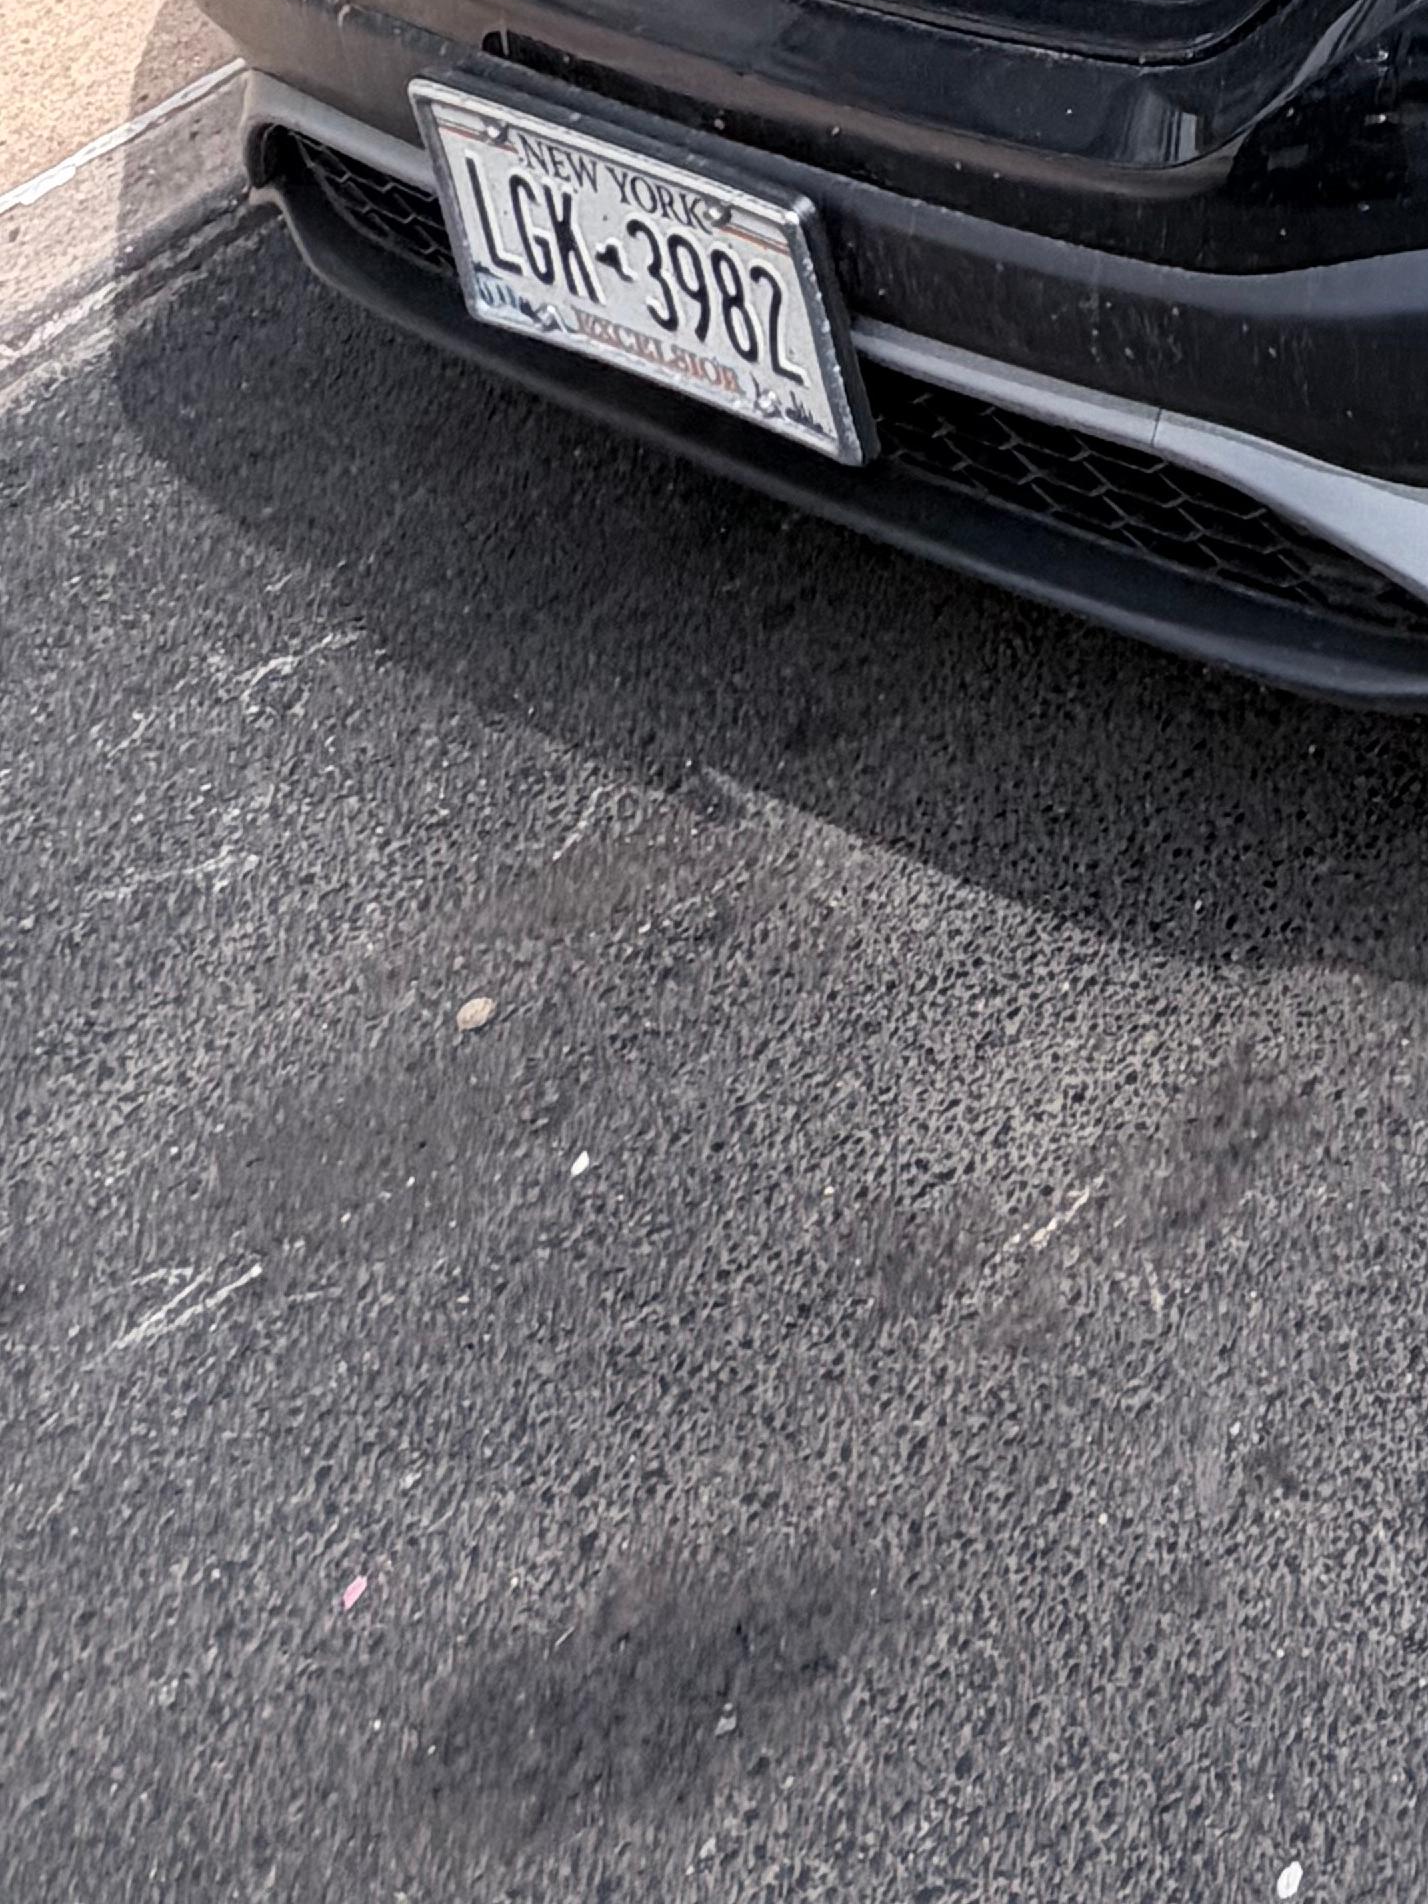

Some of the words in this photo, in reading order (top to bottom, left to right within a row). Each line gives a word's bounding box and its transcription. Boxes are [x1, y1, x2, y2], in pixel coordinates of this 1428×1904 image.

[519, 134, 600, 194] NEW
[606, 164, 708, 228] YORK
[572, 306, 742, 394] EXCELSIOR
